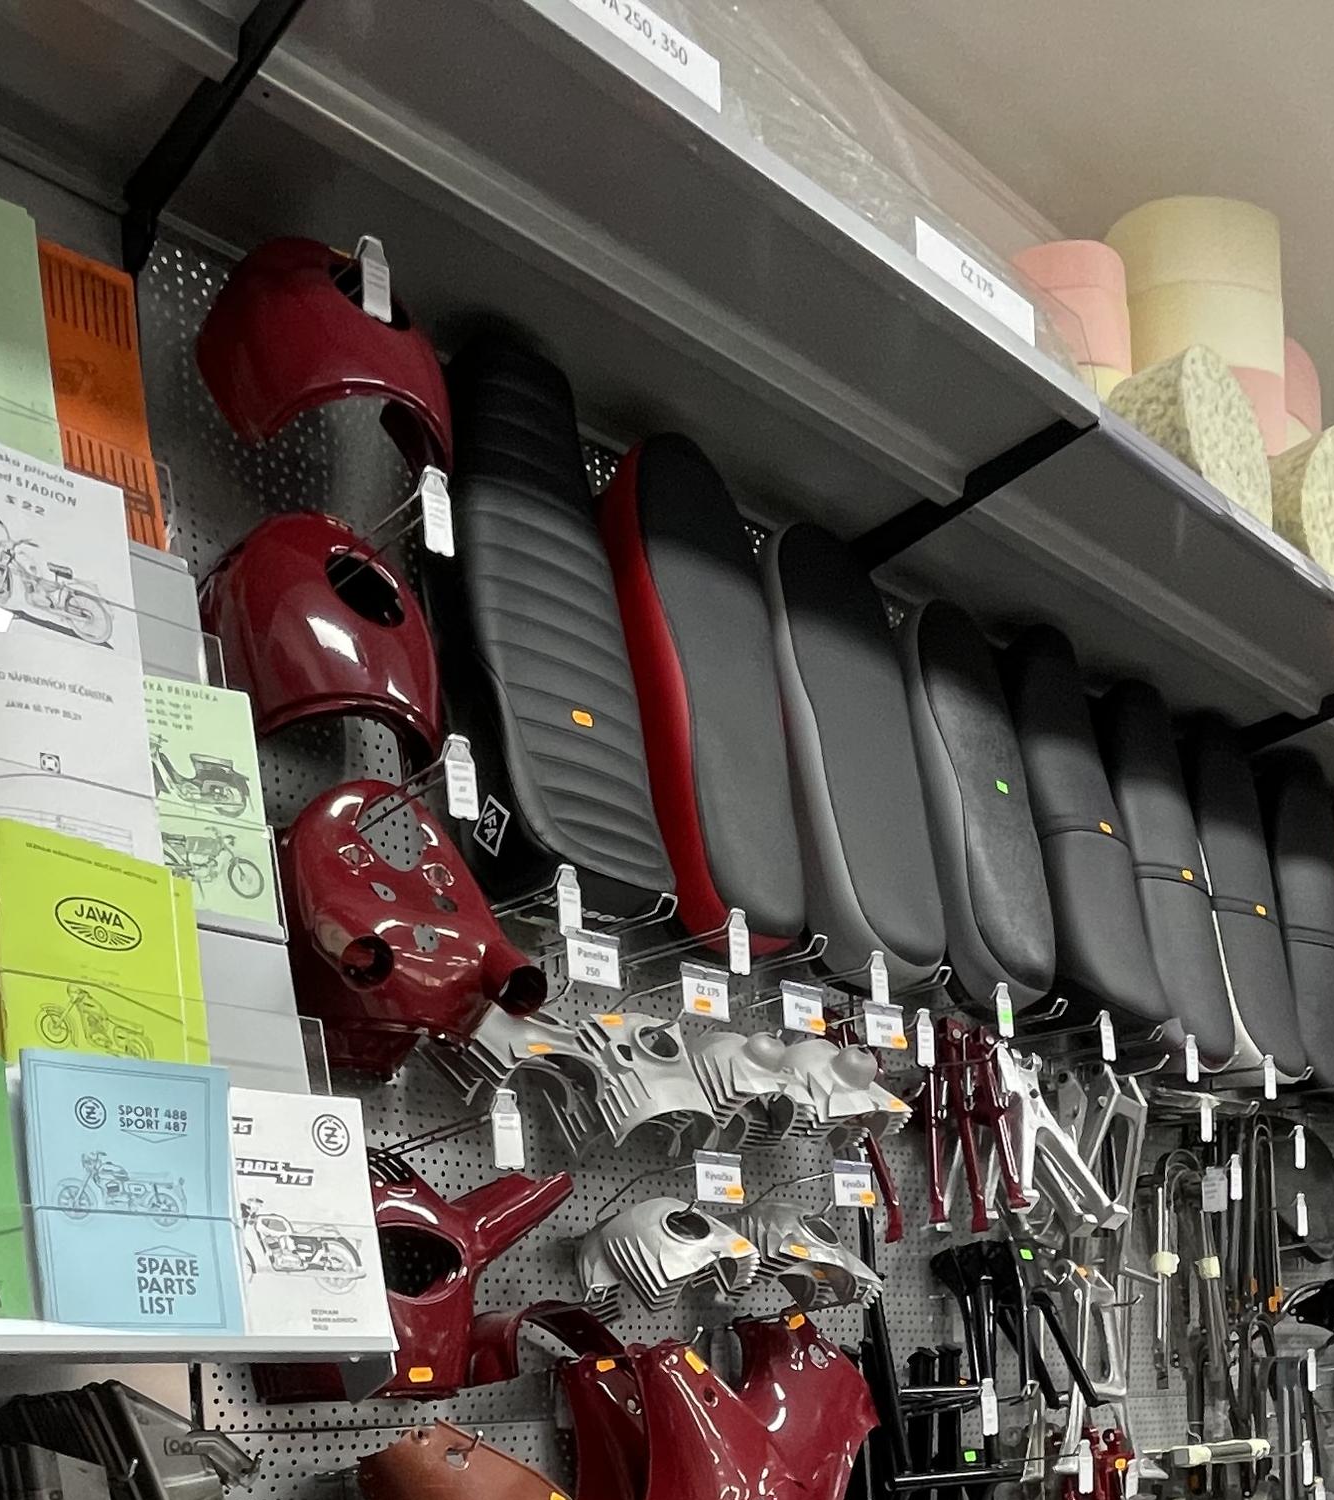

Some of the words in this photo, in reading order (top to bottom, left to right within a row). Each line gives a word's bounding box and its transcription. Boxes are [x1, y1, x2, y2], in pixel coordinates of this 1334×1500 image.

[661, 33, 687, 66] 350
[976, 274, 994, 298] 175
[15, 476, 77, 507] STADION
[484, 808, 497, 842] IFA
[75, 903, 125, 930] JAWA
[585, 966, 601, 977] 250
[118, 1104, 159, 1119] SPORT
[164, 1108, 188, 1120] 488
[119, 1118, 159, 1131] SPORT
[164, 1120, 187, 1133] 487
[137, 1256, 199, 1277] SPARE
[137, 1276, 197, 1296] PARTS
[139, 1296, 175, 1316] LIST
